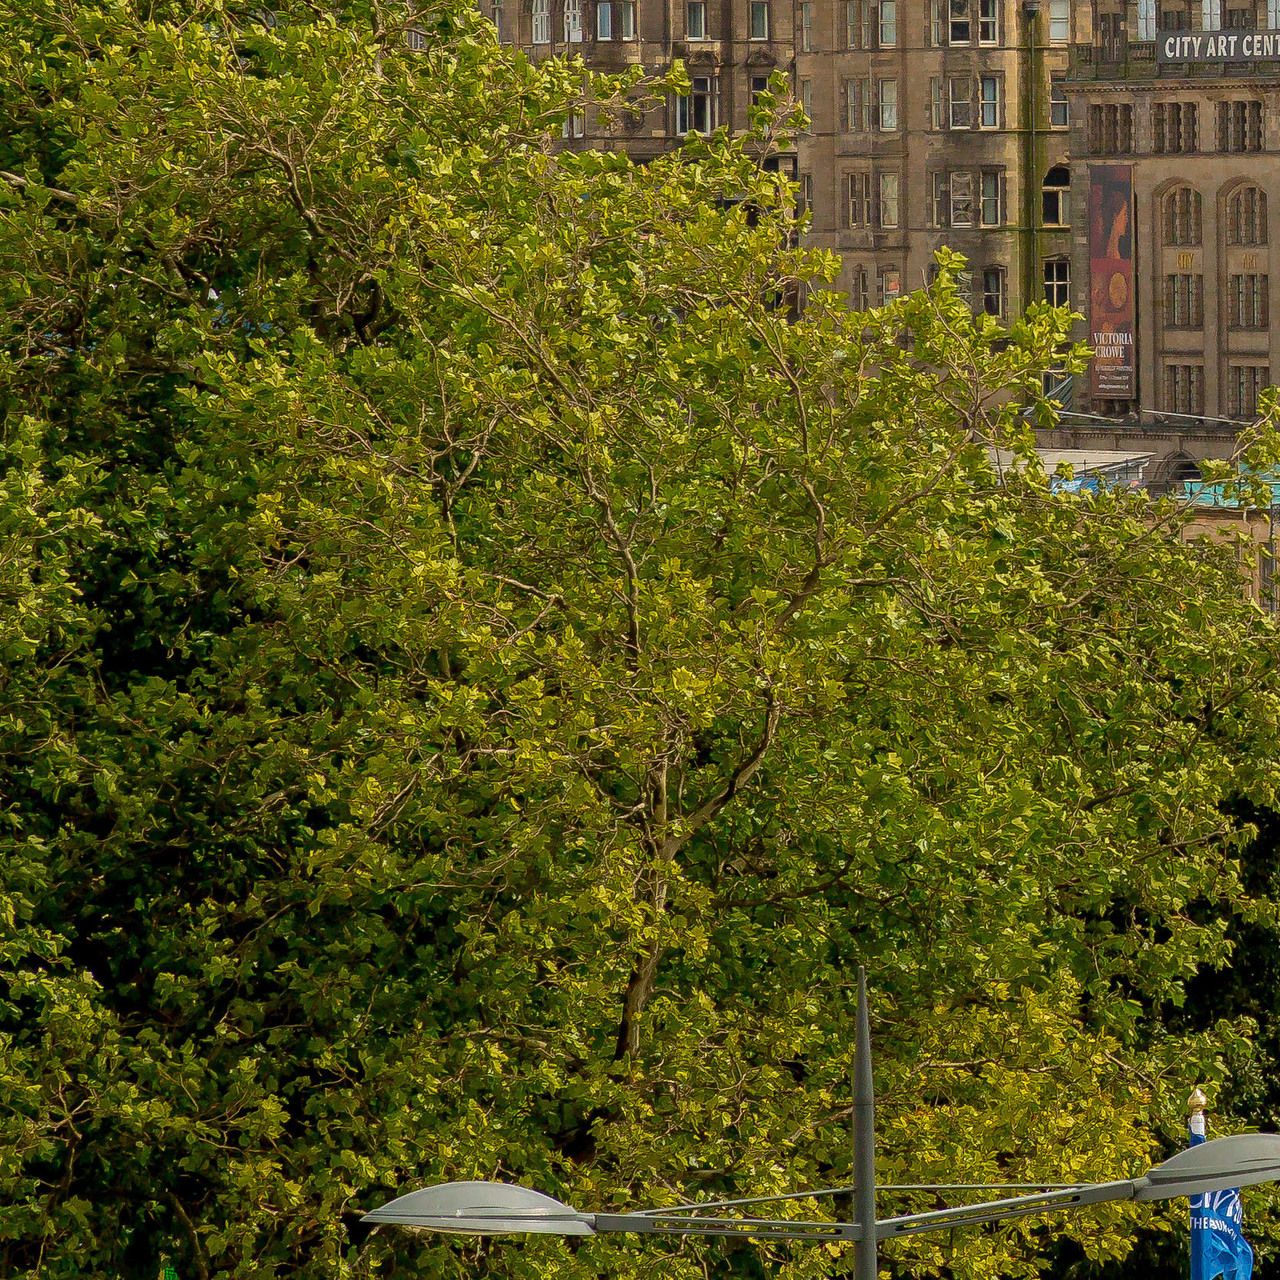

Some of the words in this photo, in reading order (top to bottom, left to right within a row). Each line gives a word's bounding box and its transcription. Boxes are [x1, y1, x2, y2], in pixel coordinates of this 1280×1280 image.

[1164, 35, 1202, 58] CITY
[1206, 35, 1238, 57] ART
[1094, 332, 1133, 345] VICTORIA
[1095, 346, 1125, 358] CROWE
